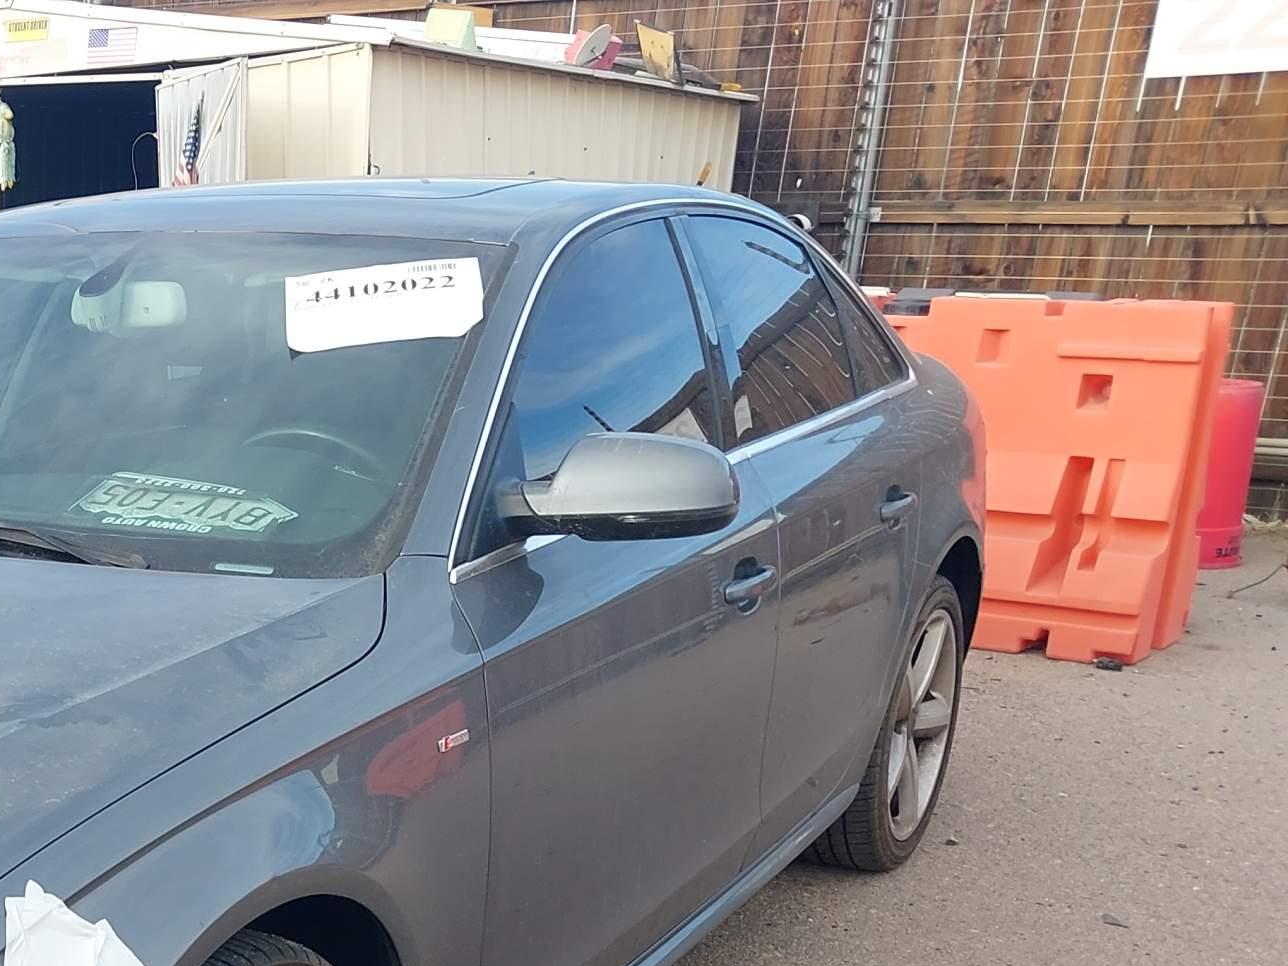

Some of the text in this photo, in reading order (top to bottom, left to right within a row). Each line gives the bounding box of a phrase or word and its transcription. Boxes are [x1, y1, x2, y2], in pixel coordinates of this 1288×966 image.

[306, 275, 456, 303] 44102022
[101, 516, 212, 534] CROWN AUTO
